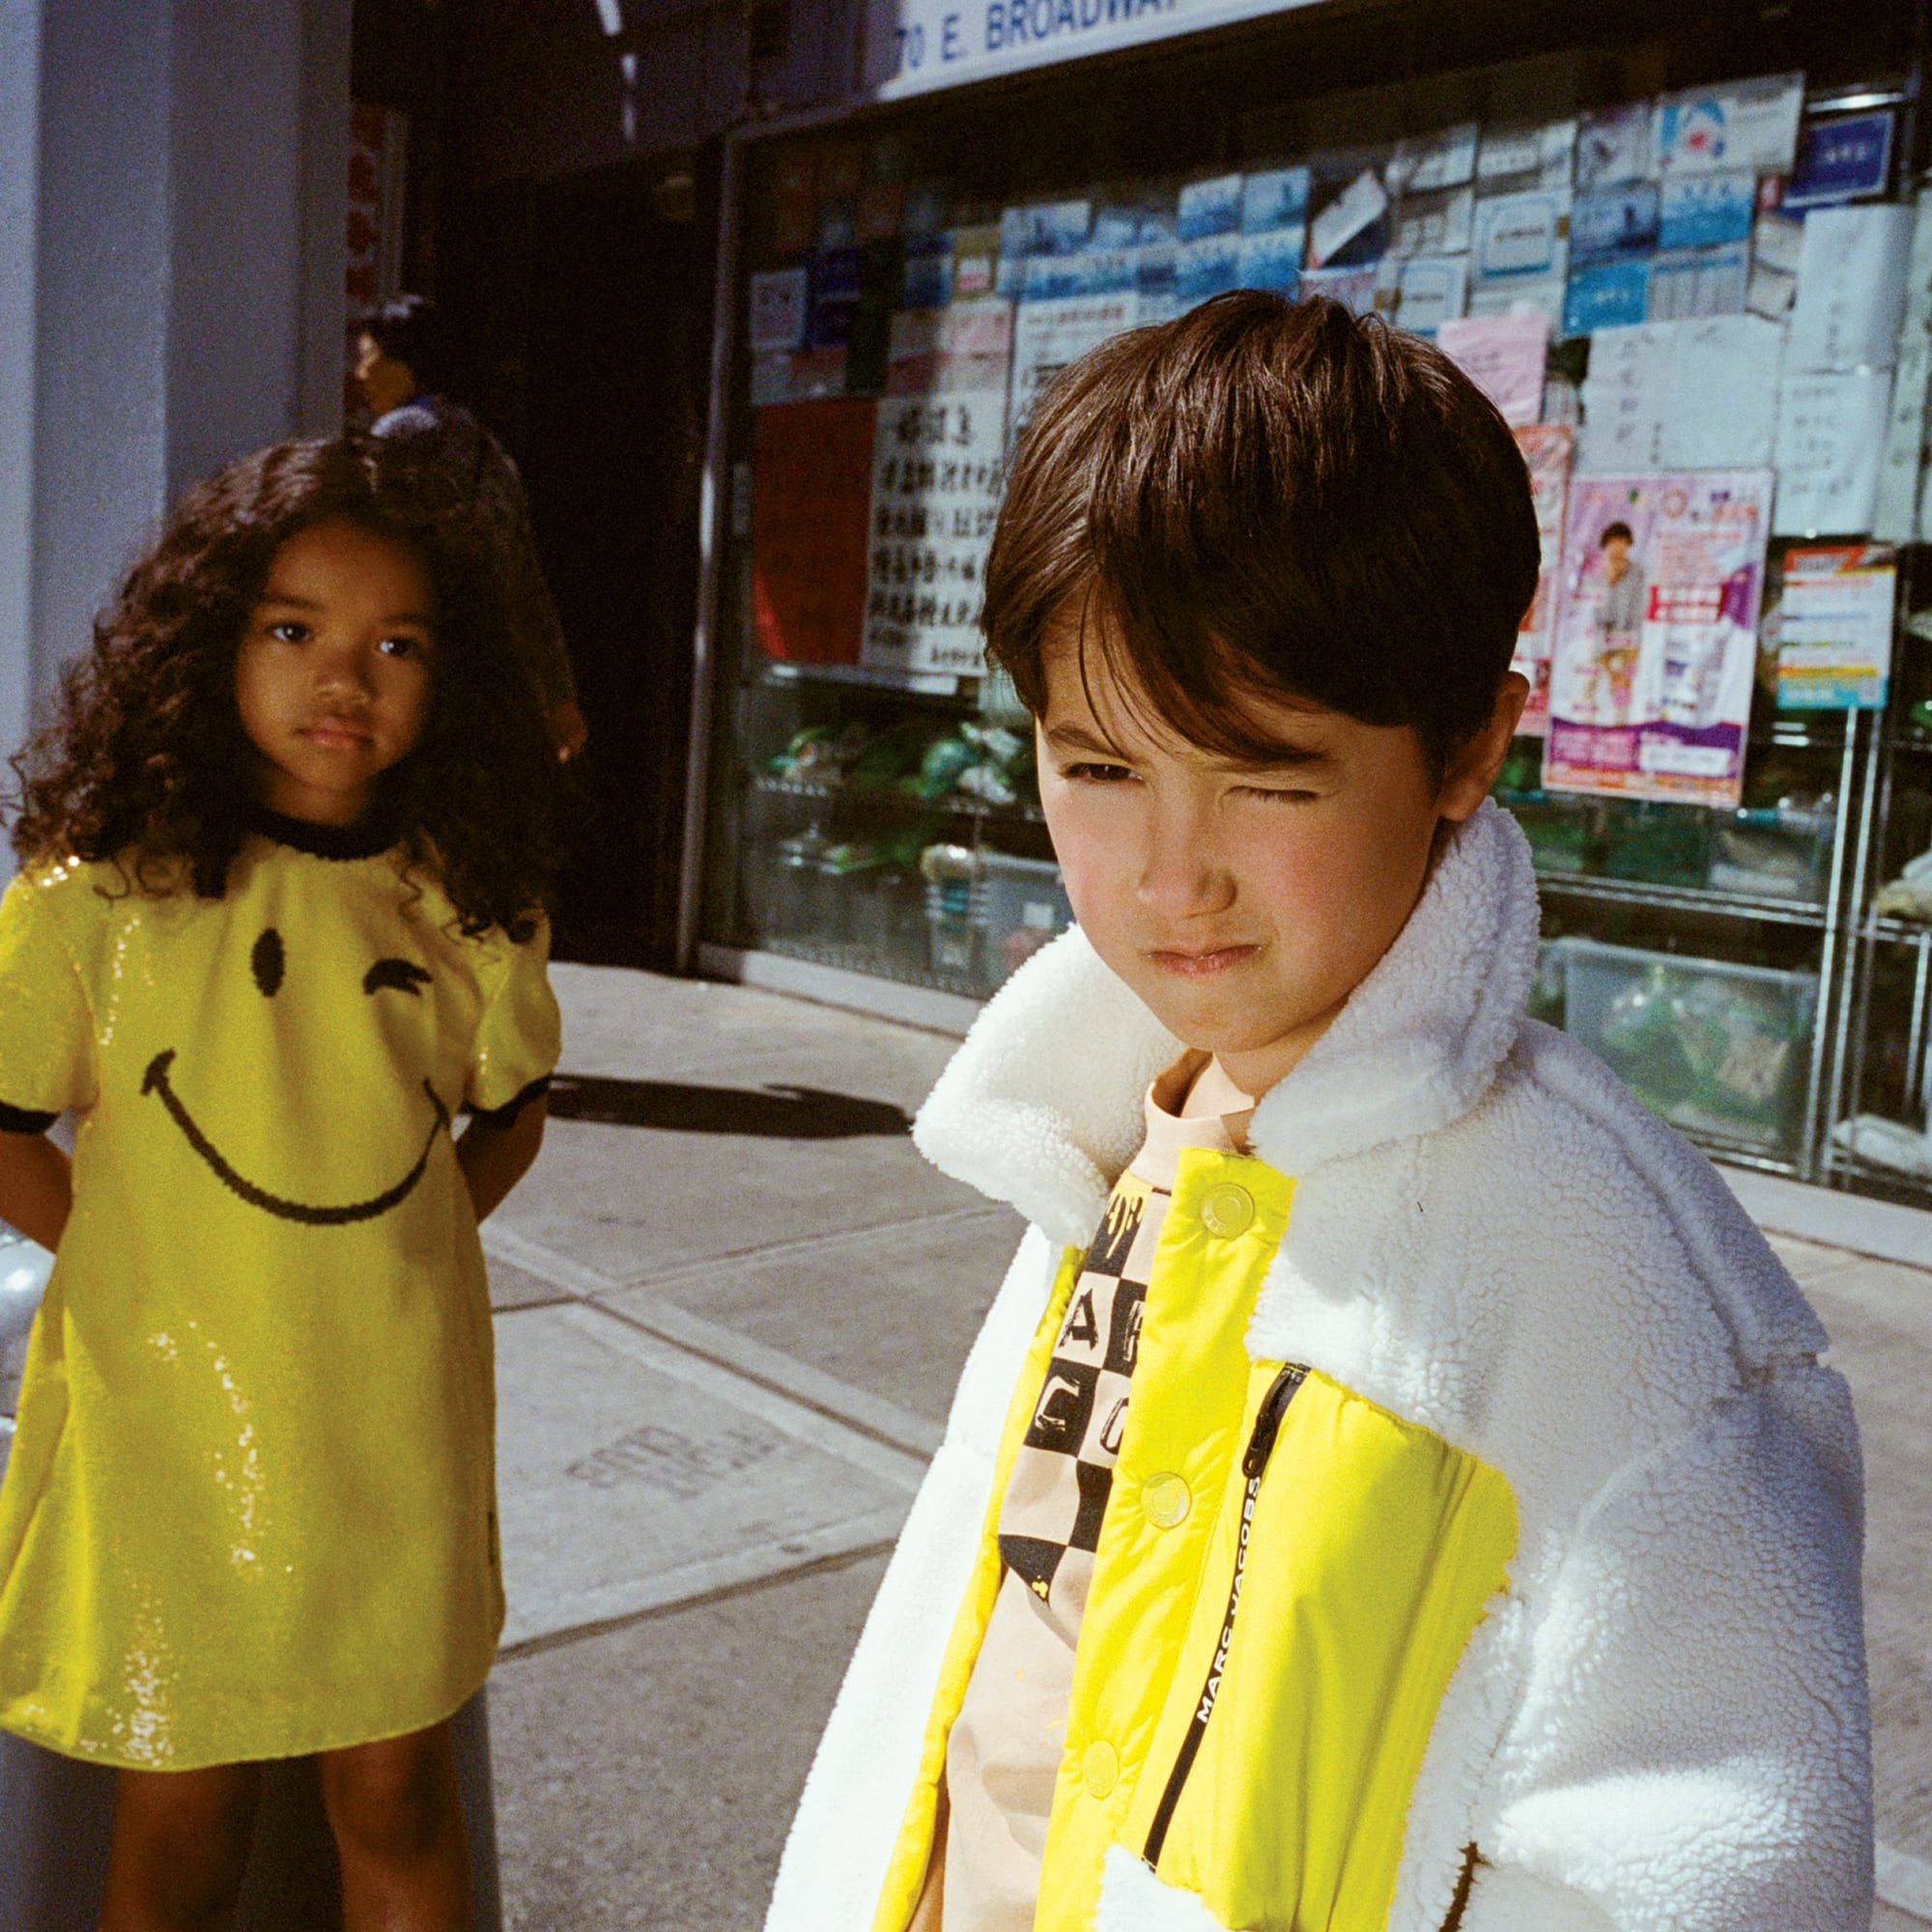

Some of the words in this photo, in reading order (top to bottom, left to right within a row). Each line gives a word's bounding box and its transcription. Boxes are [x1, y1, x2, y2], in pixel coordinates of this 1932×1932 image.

[986, 0, 1173, 49] BROAD
[1197, 1626, 1232, 1723] MARC
[1231, 1476, 1261, 1616] JACOBS
